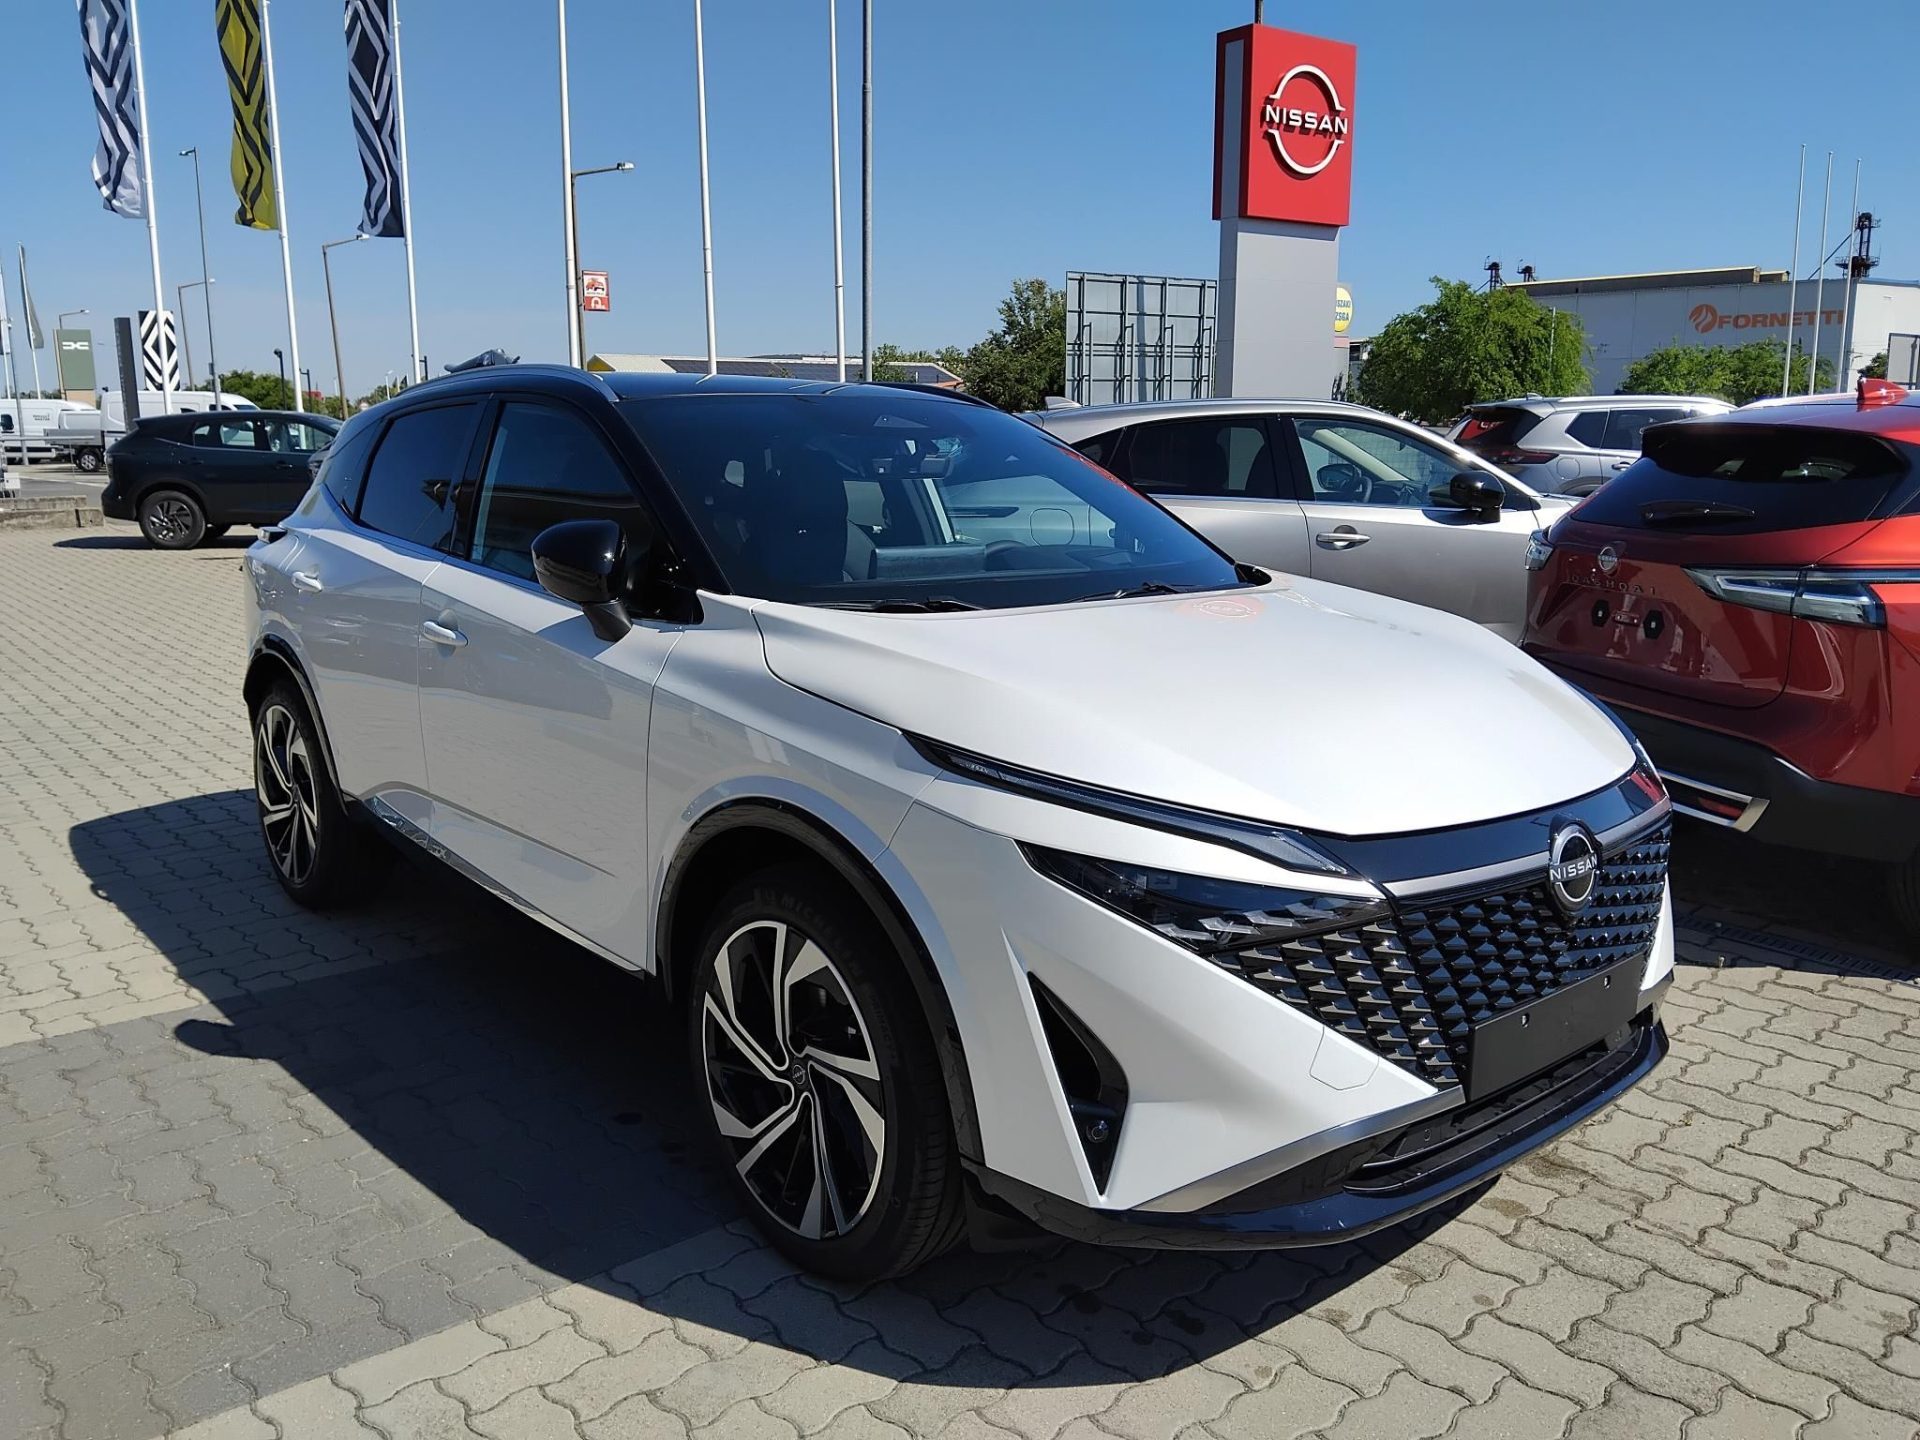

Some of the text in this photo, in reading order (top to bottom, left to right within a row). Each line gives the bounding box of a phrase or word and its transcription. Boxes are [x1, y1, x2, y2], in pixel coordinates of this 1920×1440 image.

[1265, 104, 1348, 134] NISSAN
[1336, 300, 1351, 309] SZAKI
[1718, 310, 1845, 329] FORNETTI
[1550, 854, 1598, 882] NISSAN
